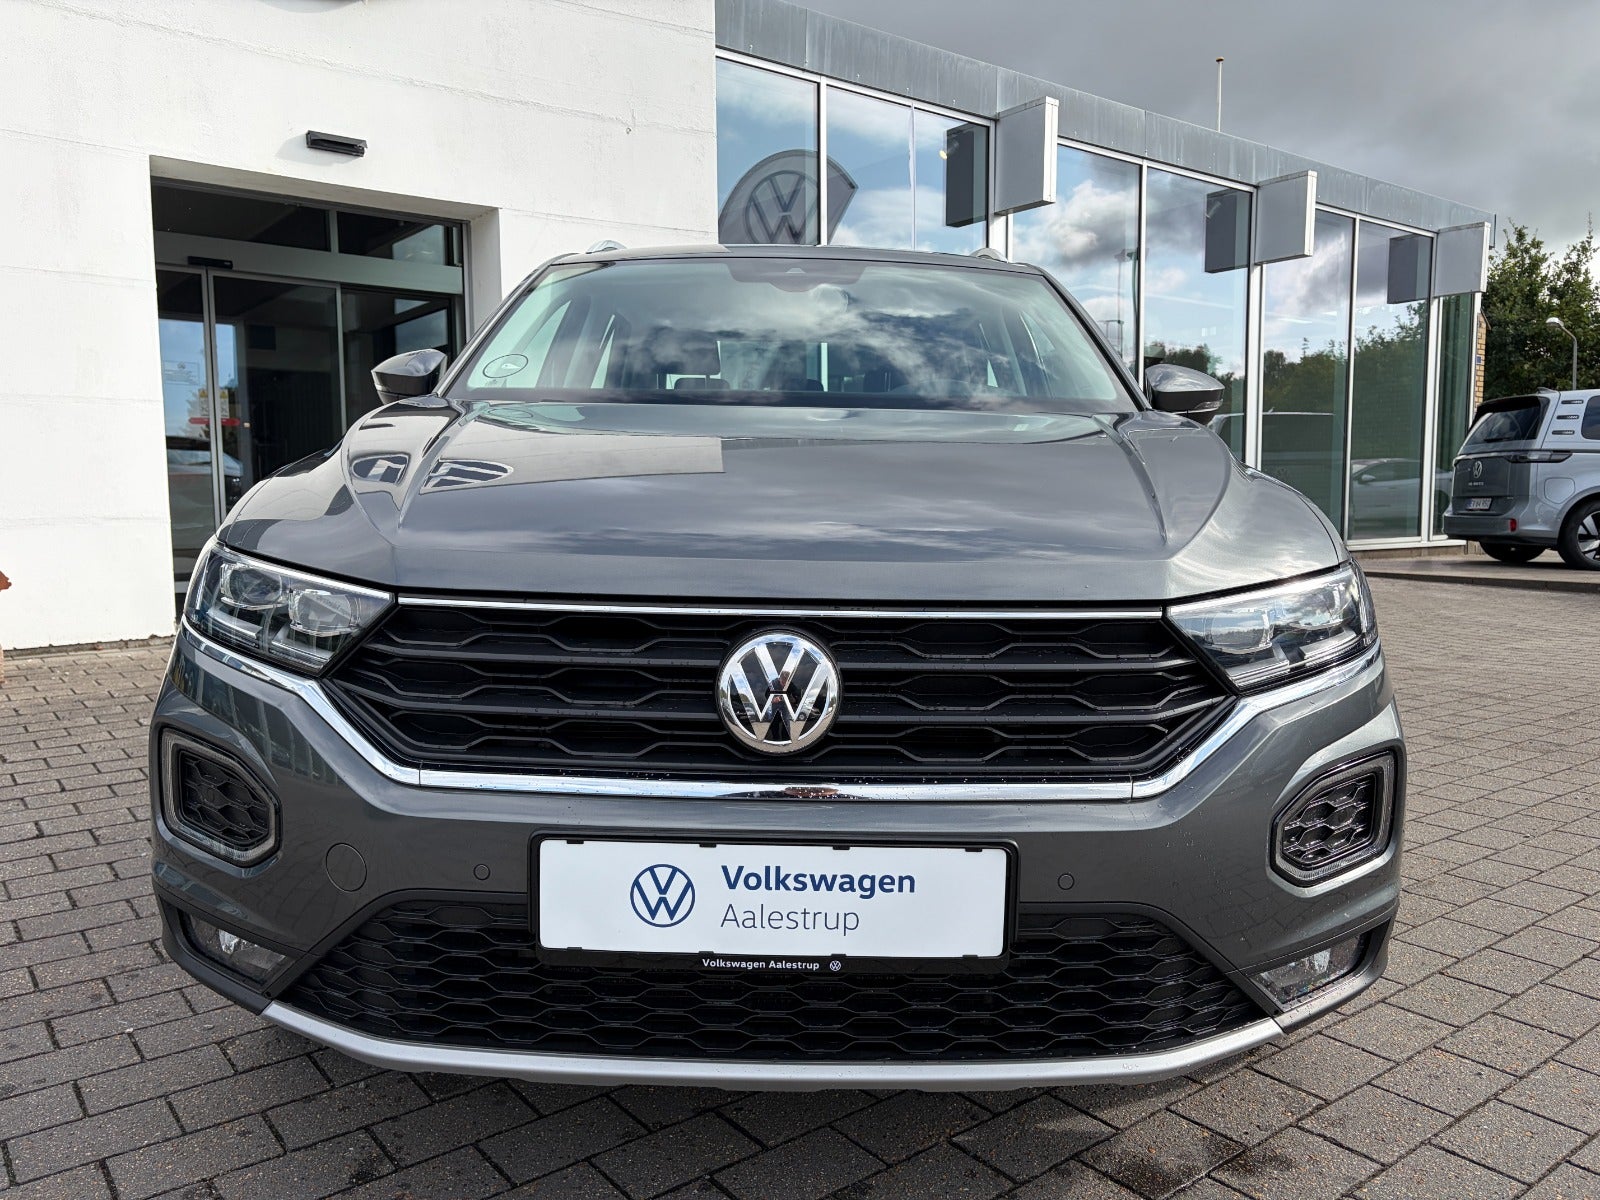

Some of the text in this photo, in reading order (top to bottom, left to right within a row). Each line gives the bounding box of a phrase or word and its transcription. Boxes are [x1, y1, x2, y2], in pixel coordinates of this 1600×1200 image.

[718, 632, 839, 753] VW
[630, 864, 695, 927] VW
[721, 865, 915, 900] Volkswagen
[721, 904, 860, 936] Aalestrup
[702, 958, 766, 970] Volkswagen
[769, 960, 820, 971] Aalestrup
